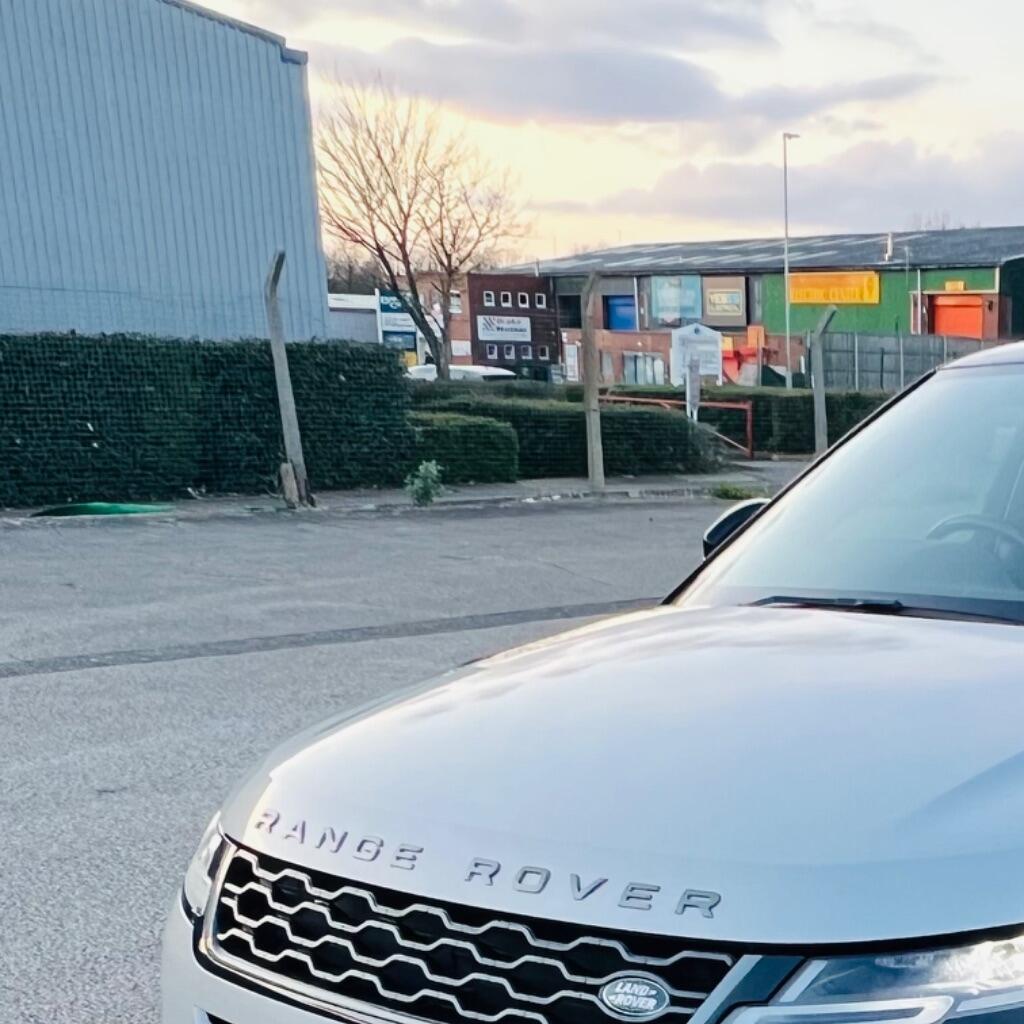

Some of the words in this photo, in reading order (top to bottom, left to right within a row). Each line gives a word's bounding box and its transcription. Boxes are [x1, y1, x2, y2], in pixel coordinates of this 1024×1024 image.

[254, 808, 424, 872] RANGE
[464, 857, 722, 919] ROVER
[615, 982, 650, 996] LAND
[614, 993, 657, 1010] ROVER
